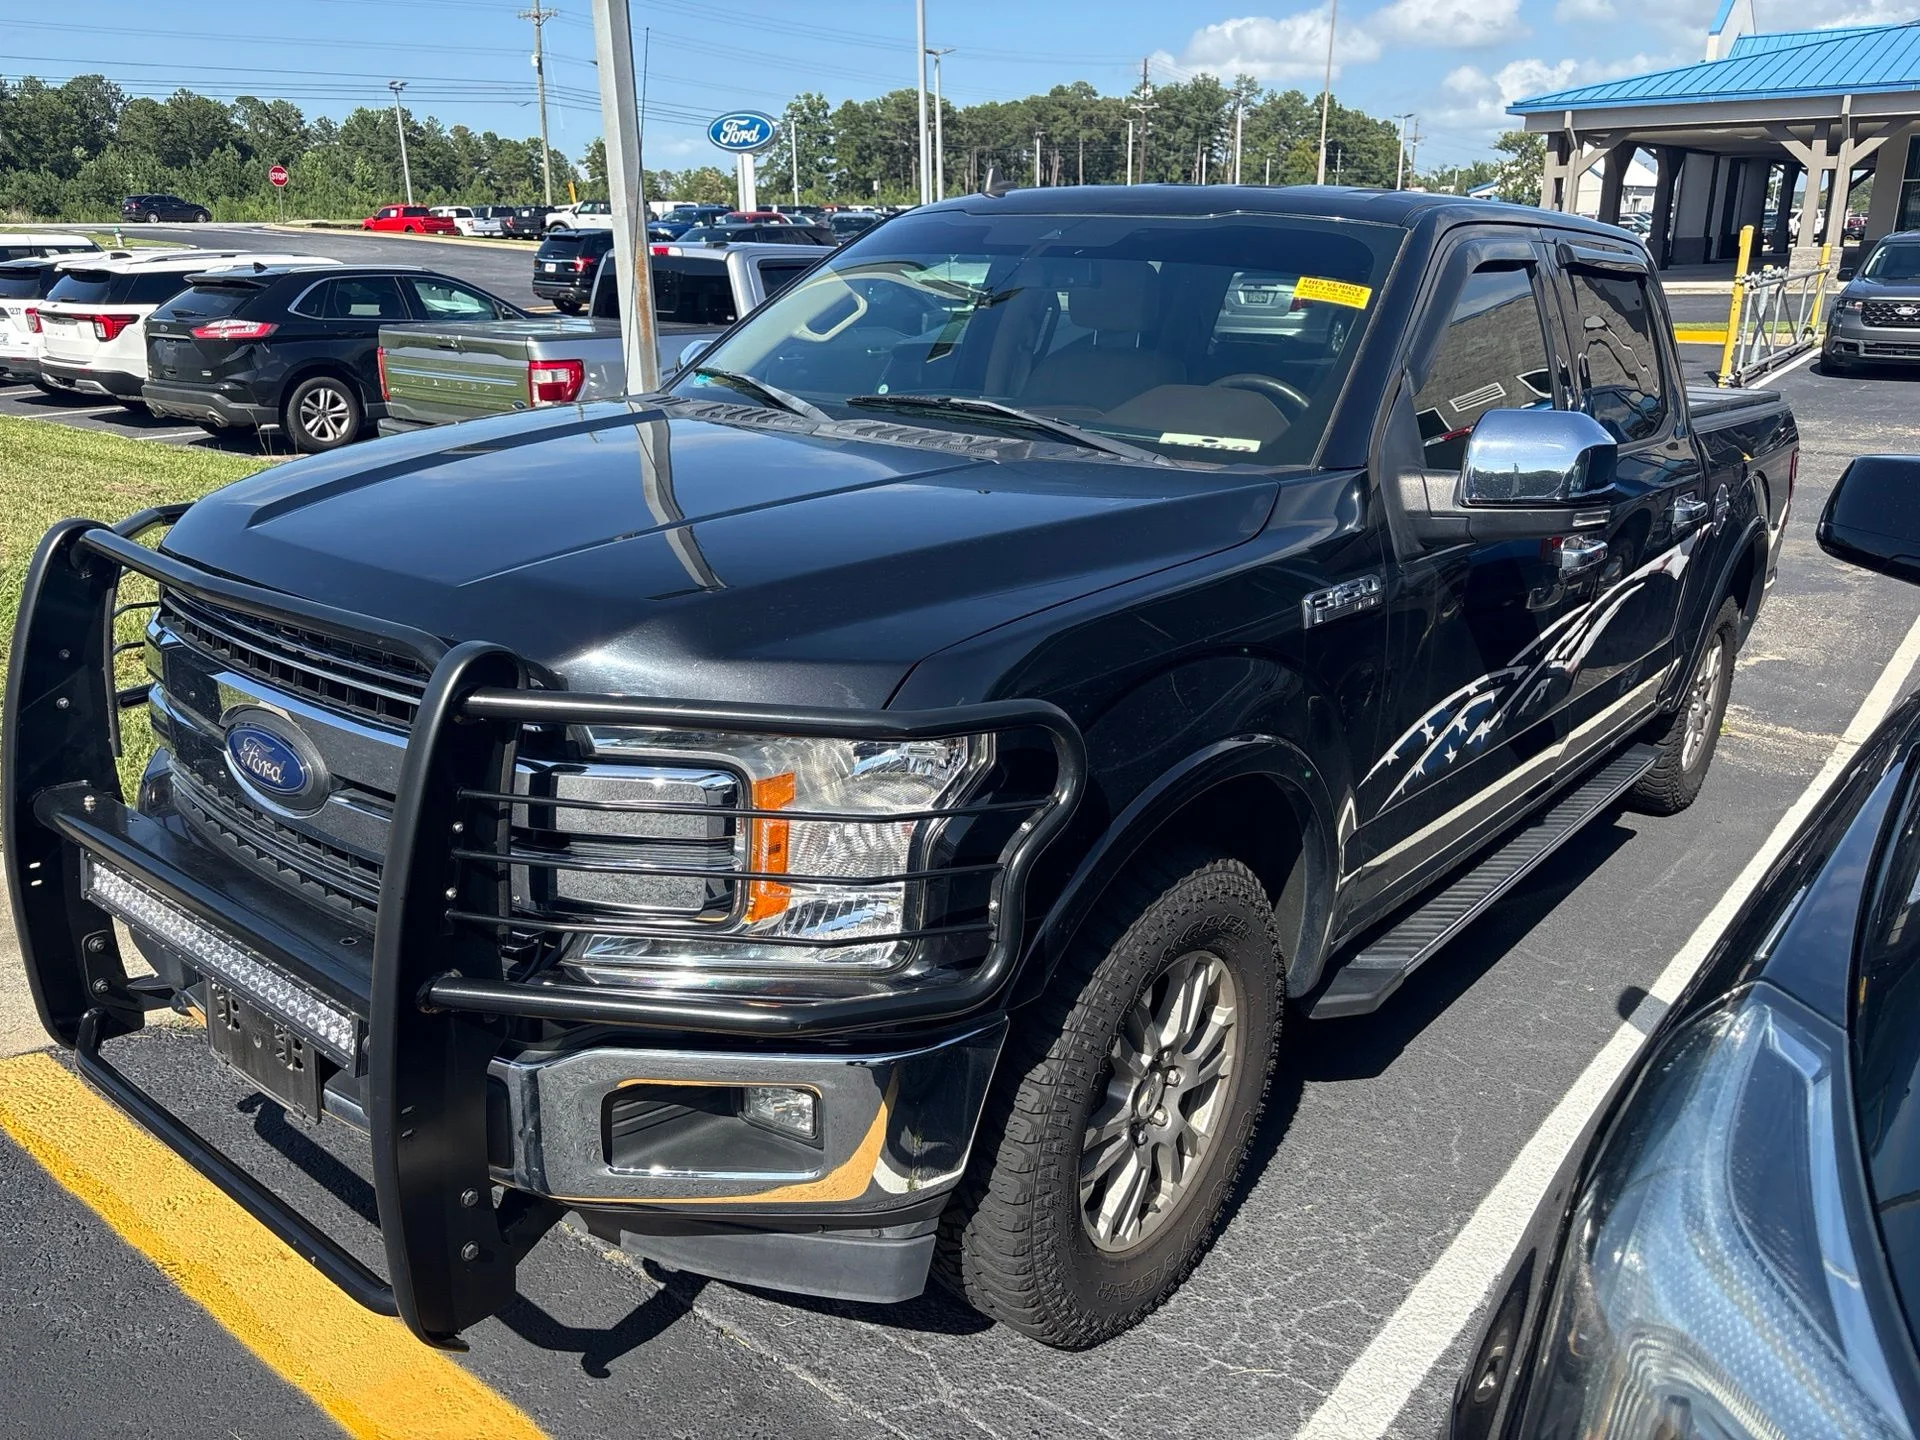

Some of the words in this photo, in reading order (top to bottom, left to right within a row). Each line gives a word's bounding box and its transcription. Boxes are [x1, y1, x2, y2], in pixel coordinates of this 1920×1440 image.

[719, 119, 761, 144] Ford
[271, 172, 287, 181] STOP
[1327, 282, 1365, 293] VEHICLE
[1340, 289, 1362, 297] SALE
[239, 736, 287, 784] Ford
[1096, 1110, 1254, 1303] GOODYEAR
